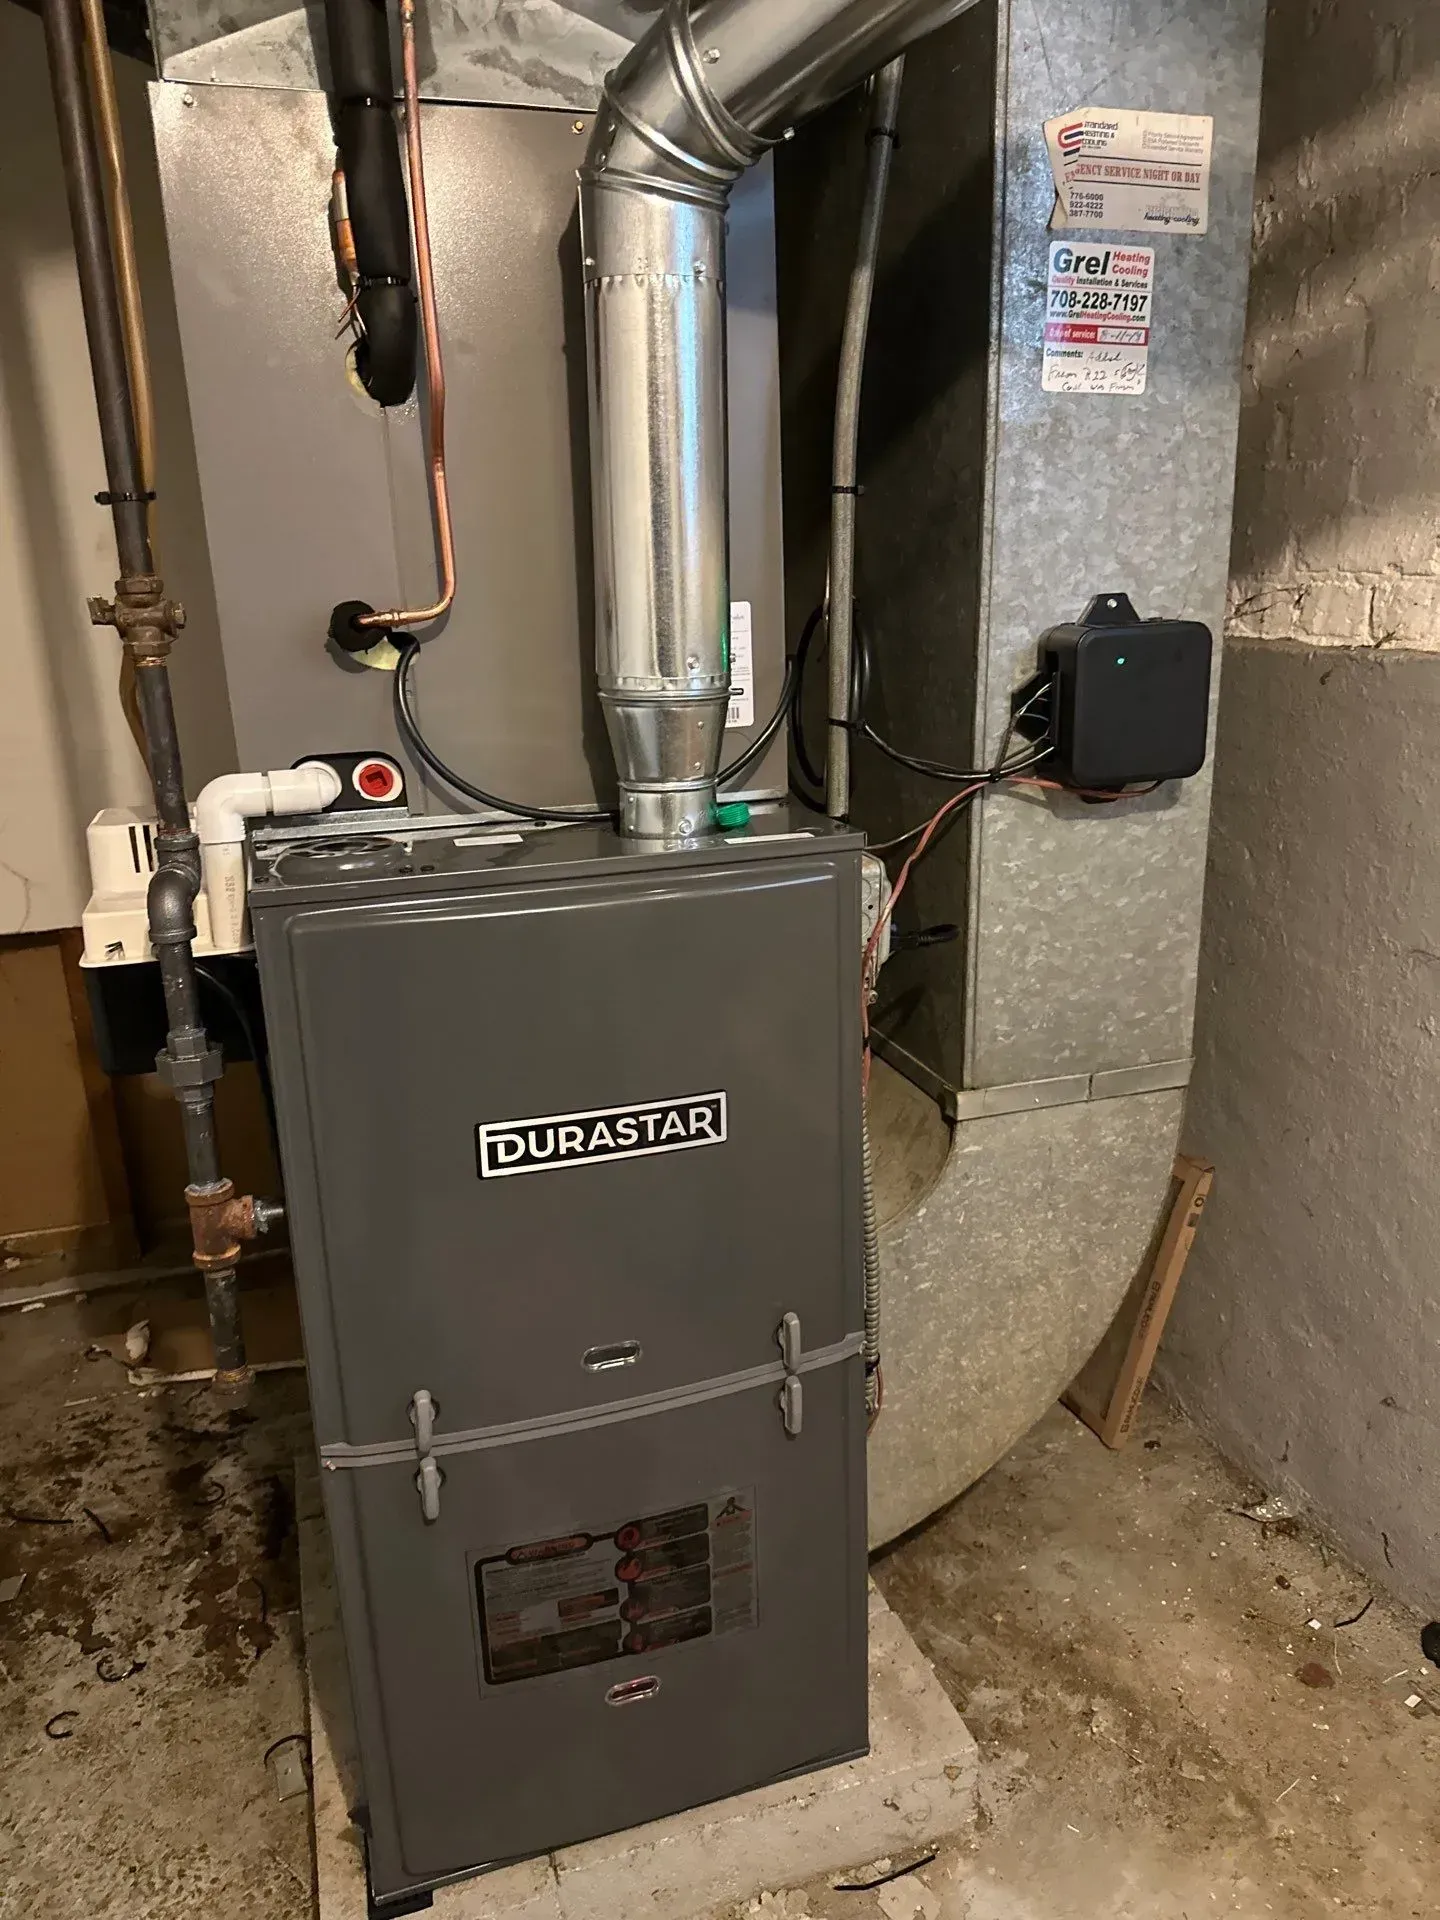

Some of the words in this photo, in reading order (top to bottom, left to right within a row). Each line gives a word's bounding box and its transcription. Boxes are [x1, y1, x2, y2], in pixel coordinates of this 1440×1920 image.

[1105, 165, 1141, 179] SERVICE
[1143, 169, 1169, 183] NIGHT
[1171, 171, 1182, 183] OR
[1184, 172, 1201, 184] DAY
[1053, 248, 1111, 275] Grel
[1112, 251, 1151, 265] Heating
[1112, 265, 1149, 278] Cooling
[1076, 276, 1113, 287] Installation
[1114, 278, 1119, 287] &
[1121, 279, 1148, 289] Services
[1050, 290, 1148, 312] 708-228-7197
[1046, 348, 1083, 358] Comments:
[490, 1106, 719, 1163] DURASTAR
